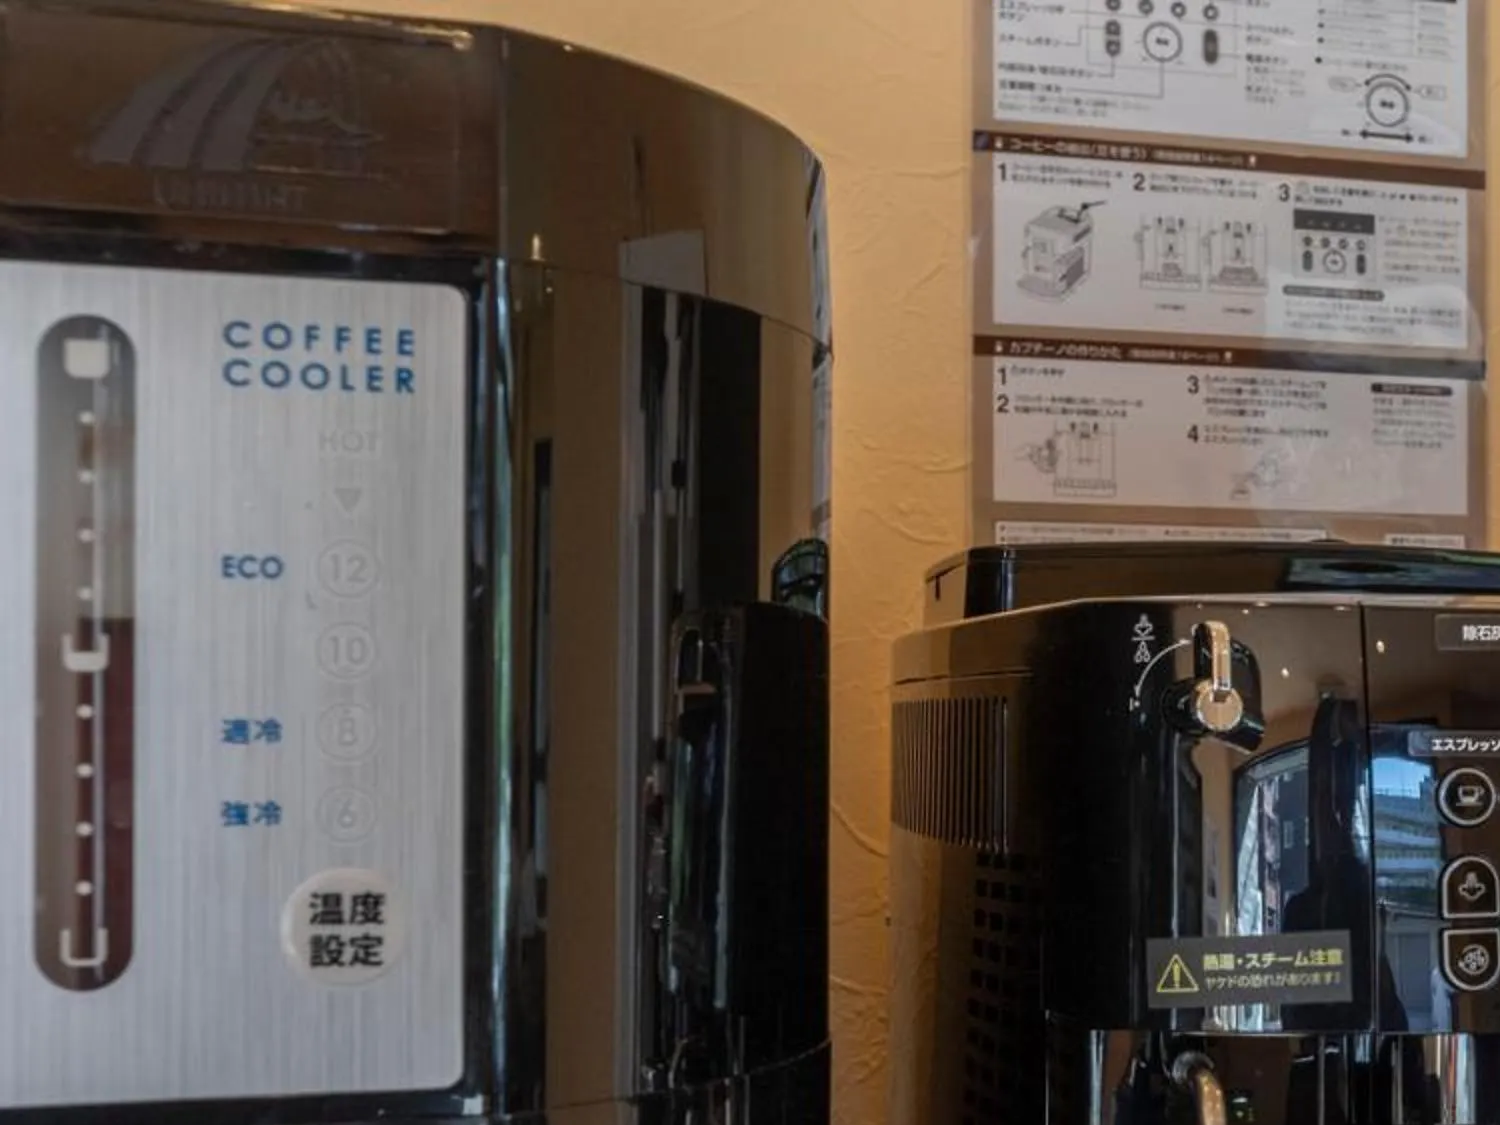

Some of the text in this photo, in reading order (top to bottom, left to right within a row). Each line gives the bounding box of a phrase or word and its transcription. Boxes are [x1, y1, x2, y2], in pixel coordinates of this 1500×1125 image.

[998, 164, 1008, 182] 1
[1134, 173, 1146, 191] 2
[1278, 184, 1290, 202] 3
[222, 320, 416, 357] COFFEE
[222, 358, 416, 395] COOLER
[997, 368, 1007, 386] 1
[1187, 375, 1199, 395] 3
[996, 395, 1009, 413] 2
[318, 431, 379, 453] HOT
[1187, 424, 1199, 443] 4
[221, 554, 285, 580] ECO
[330, 553, 369, 583] 12
[329, 634, 368, 666] 10
[338, 717, 358, 747] 8
[339, 800, 357, 829] 6
[308, 890, 387, 926] 温度
[308, 932, 385, 968] 設定
